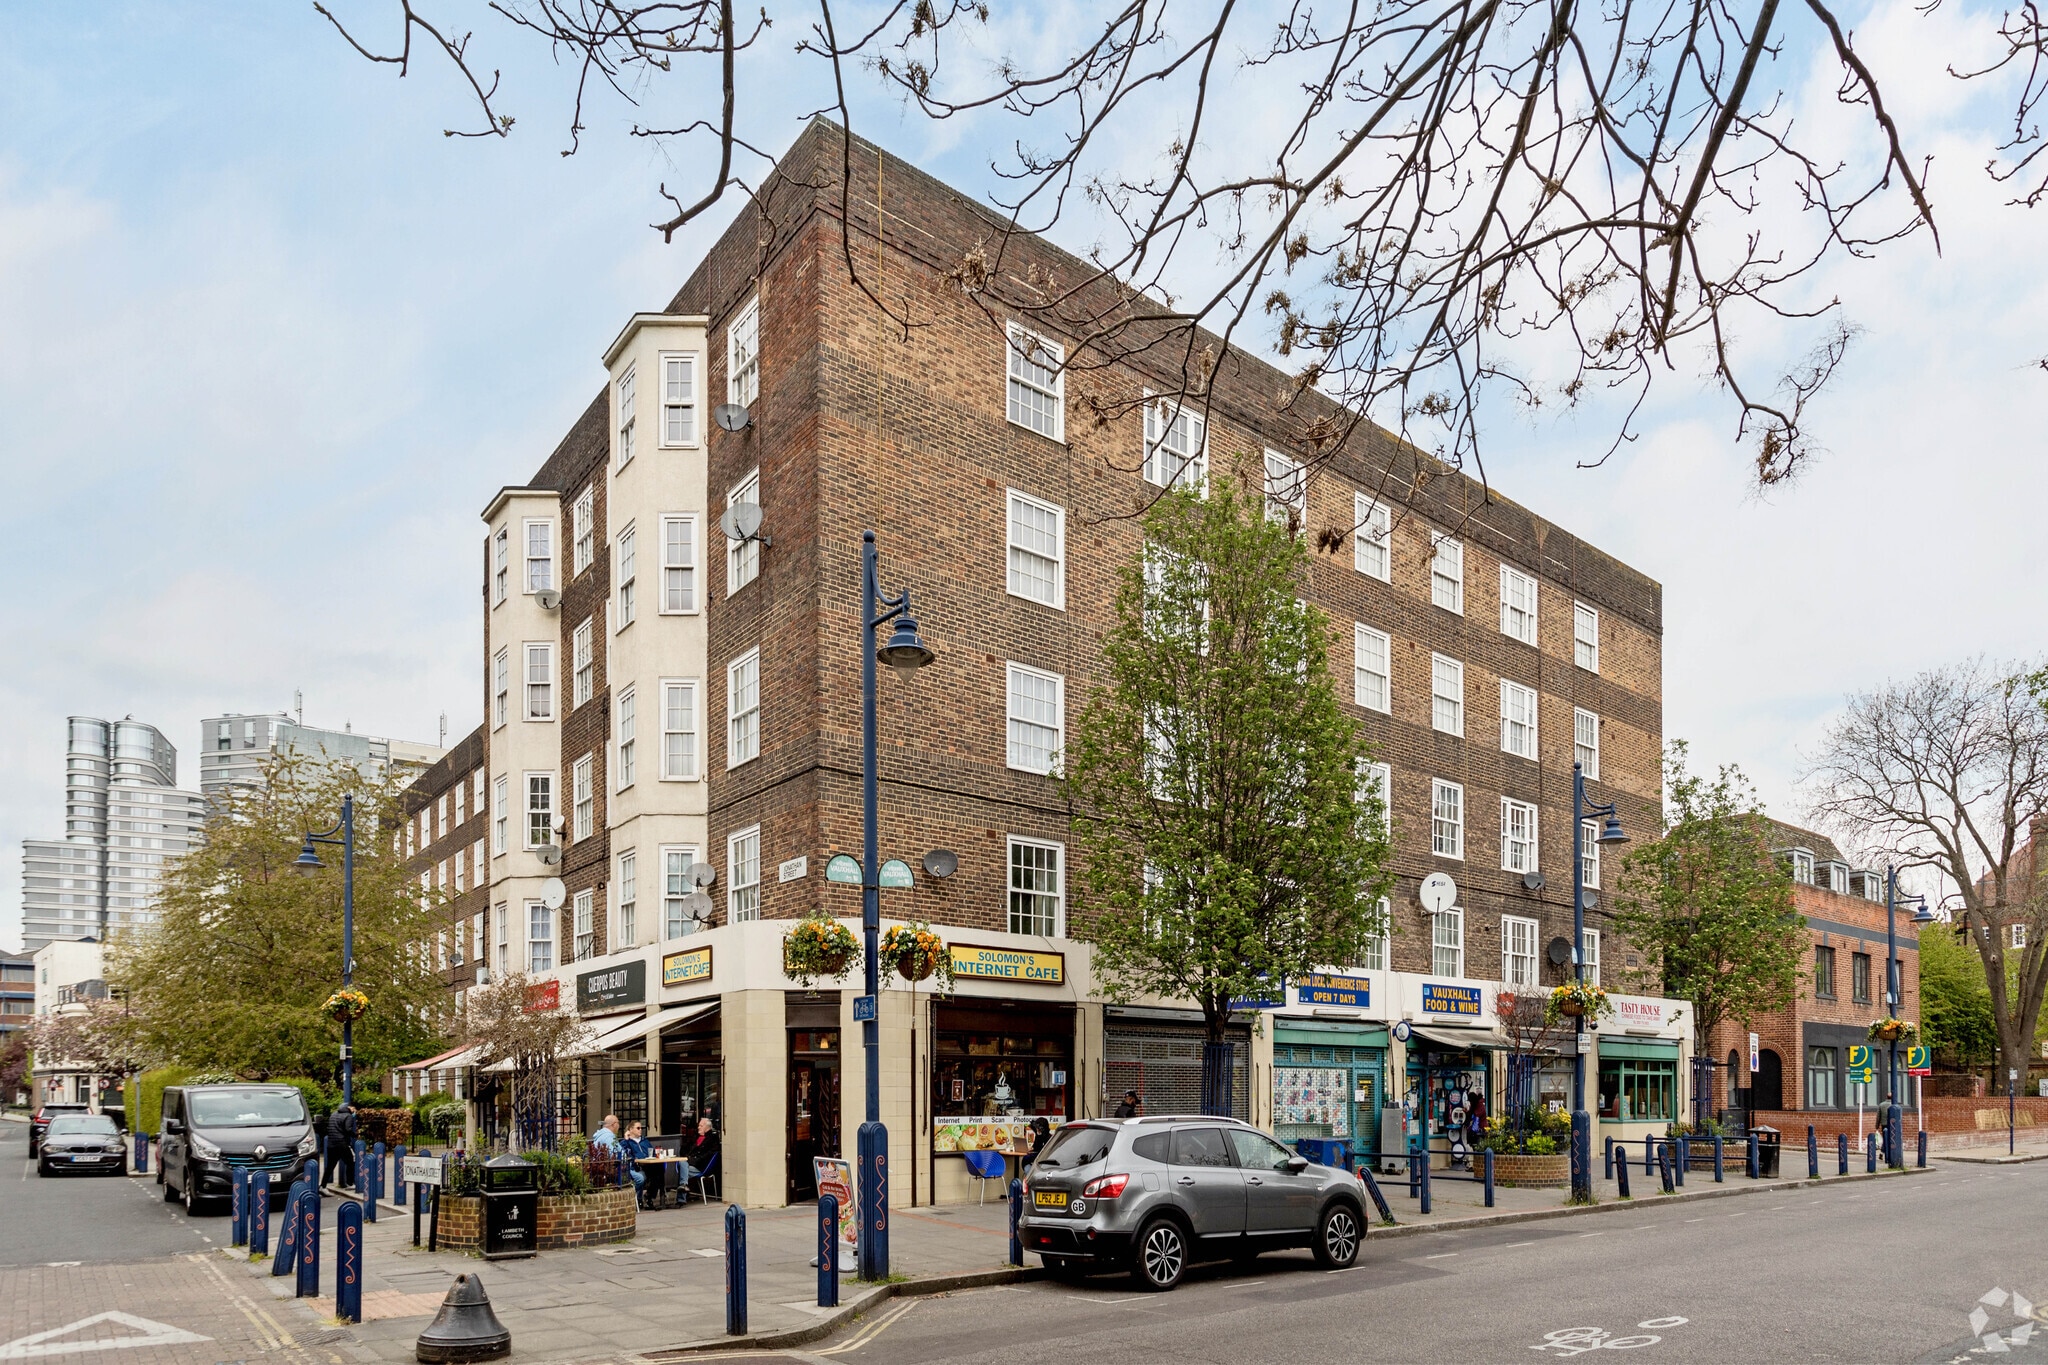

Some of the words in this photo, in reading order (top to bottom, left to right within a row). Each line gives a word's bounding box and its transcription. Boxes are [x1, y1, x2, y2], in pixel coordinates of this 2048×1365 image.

[783, 861, 802, 872] JONATHAN
[830, 865, 859, 875] VAUXHALL
[783, 869, 797, 880] STREET
[882, 870, 910, 878] VAUXHALL
[673, 953, 701, 967] SOLOMON'S
[978, 951, 1035, 965] SOLOMON'S
[693, 961, 711, 976] CAFE
[953, 960, 1020, 977] INTERNET
[1025, 966, 1060, 980] CAFE
[588, 974, 609, 993] CUERPOS
[609, 969, 628, 989] BEAUTY
[1311, 975, 1326, 988] LOCAL
[1355, 979, 1369, 992] STORE
[1313, 991, 1332, 1002] OPEN
[1333, 993, 1338, 1003] 7
[1339, 993, 1356, 1005] DAYS
[1432, 986, 1472, 1001] VAUXHALL
[1425, 998, 1448, 1012] FOOD
[1450, 1001, 1456, 1012] &
[1458, 1001, 1479, 1013] WINE
[1620, 1001, 1639, 1014] TASTY
[1640, 1003, 1661, 1016] HOUSE
[404, 1165, 428, 1177] JONATHAN
[428, 1166, 441, 1179] STREET
[1038, 1193, 1052, 1204] LP62
[1053, 1194, 1064, 1204] JEJ
[1072, 1202, 1085, 1212] GB
